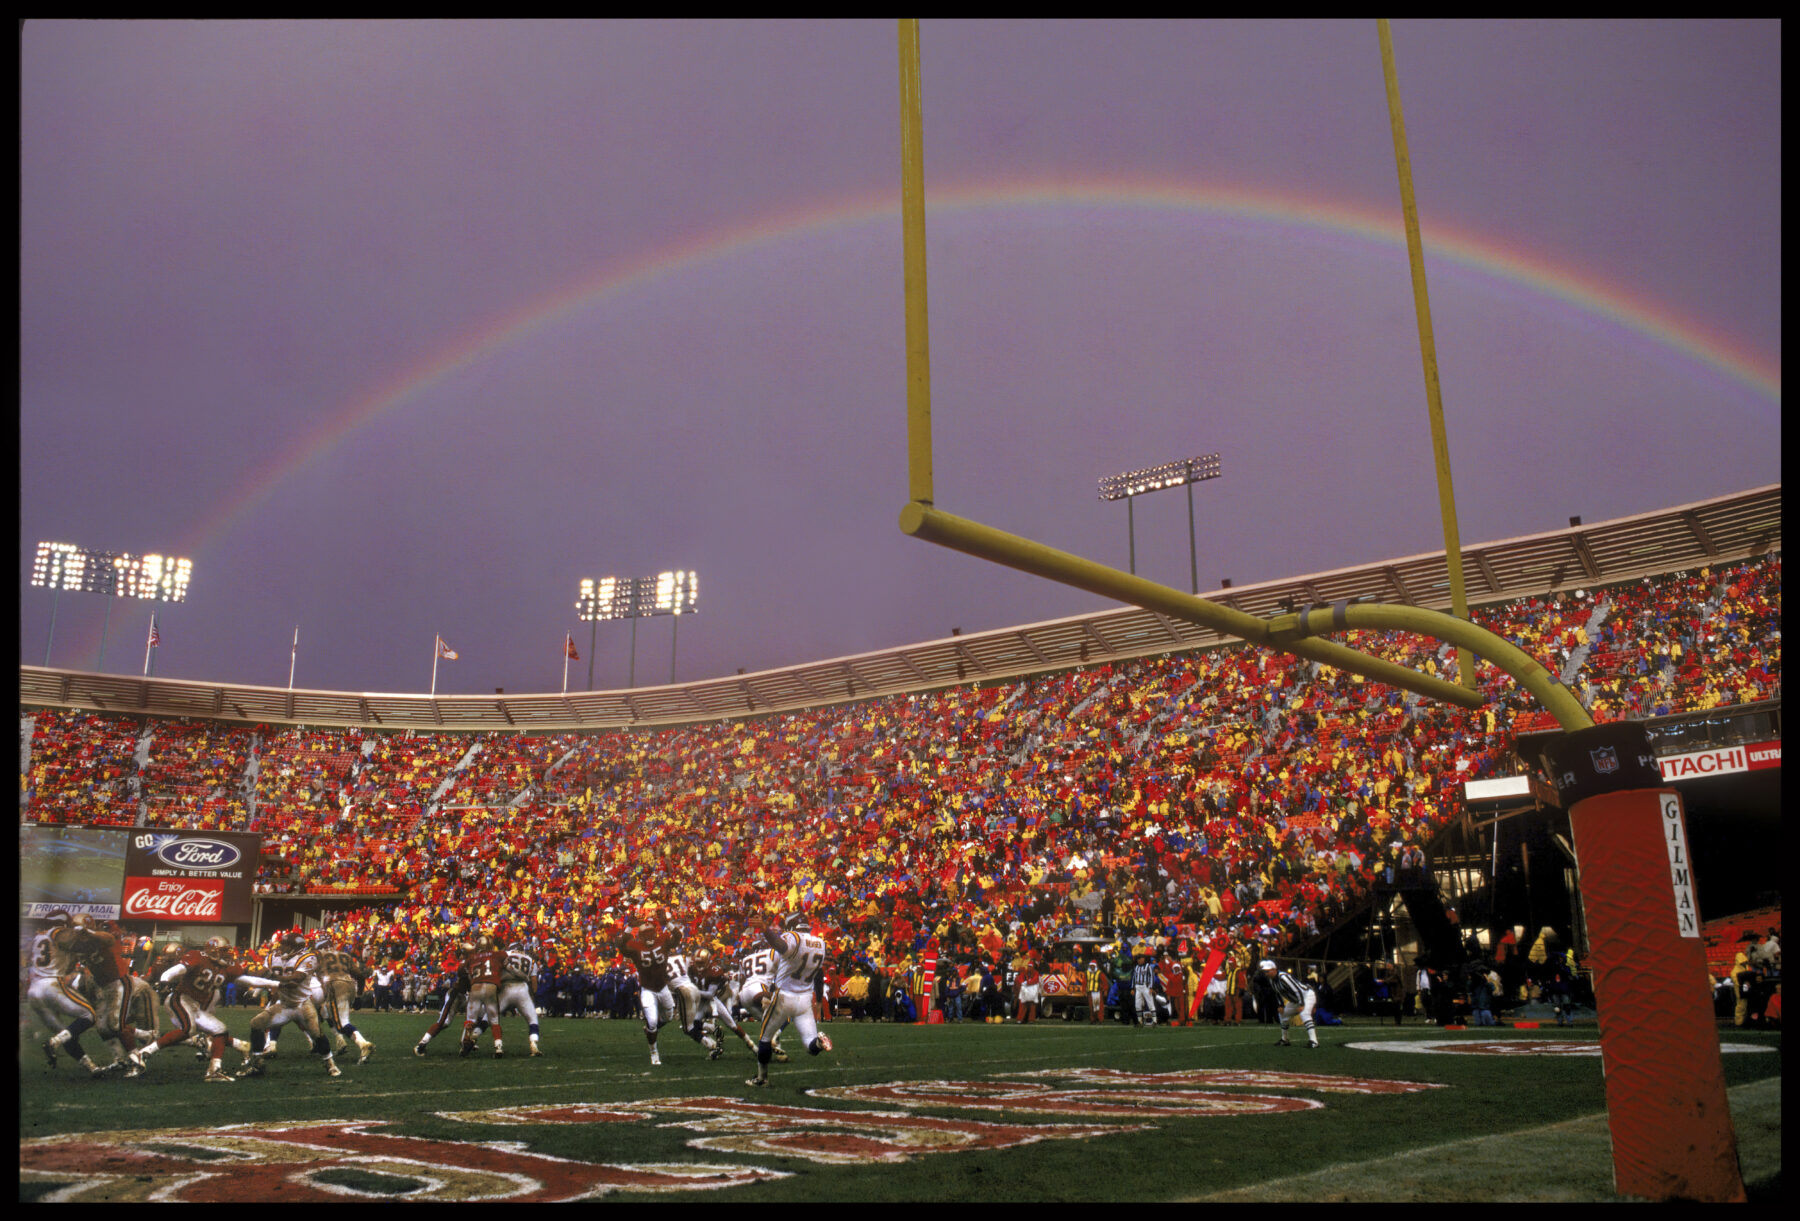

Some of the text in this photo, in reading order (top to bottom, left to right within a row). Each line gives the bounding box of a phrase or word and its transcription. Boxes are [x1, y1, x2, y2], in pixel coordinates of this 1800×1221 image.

[135, 833, 154, 849] GO
[174, 842, 225, 863] Ford
[1664, 800, 1695, 932] GILMAN
[158, 881, 185, 892] Enjoy
[34, 903, 115, 914] PRIORITY MAIL
[125, 887, 222, 917] Coca-Cola
[1177, 939, 1189, 953] 4
[640, 946, 665, 968] 55
[744, 954, 767, 978] 85
[790, 952, 824, 983] 17
